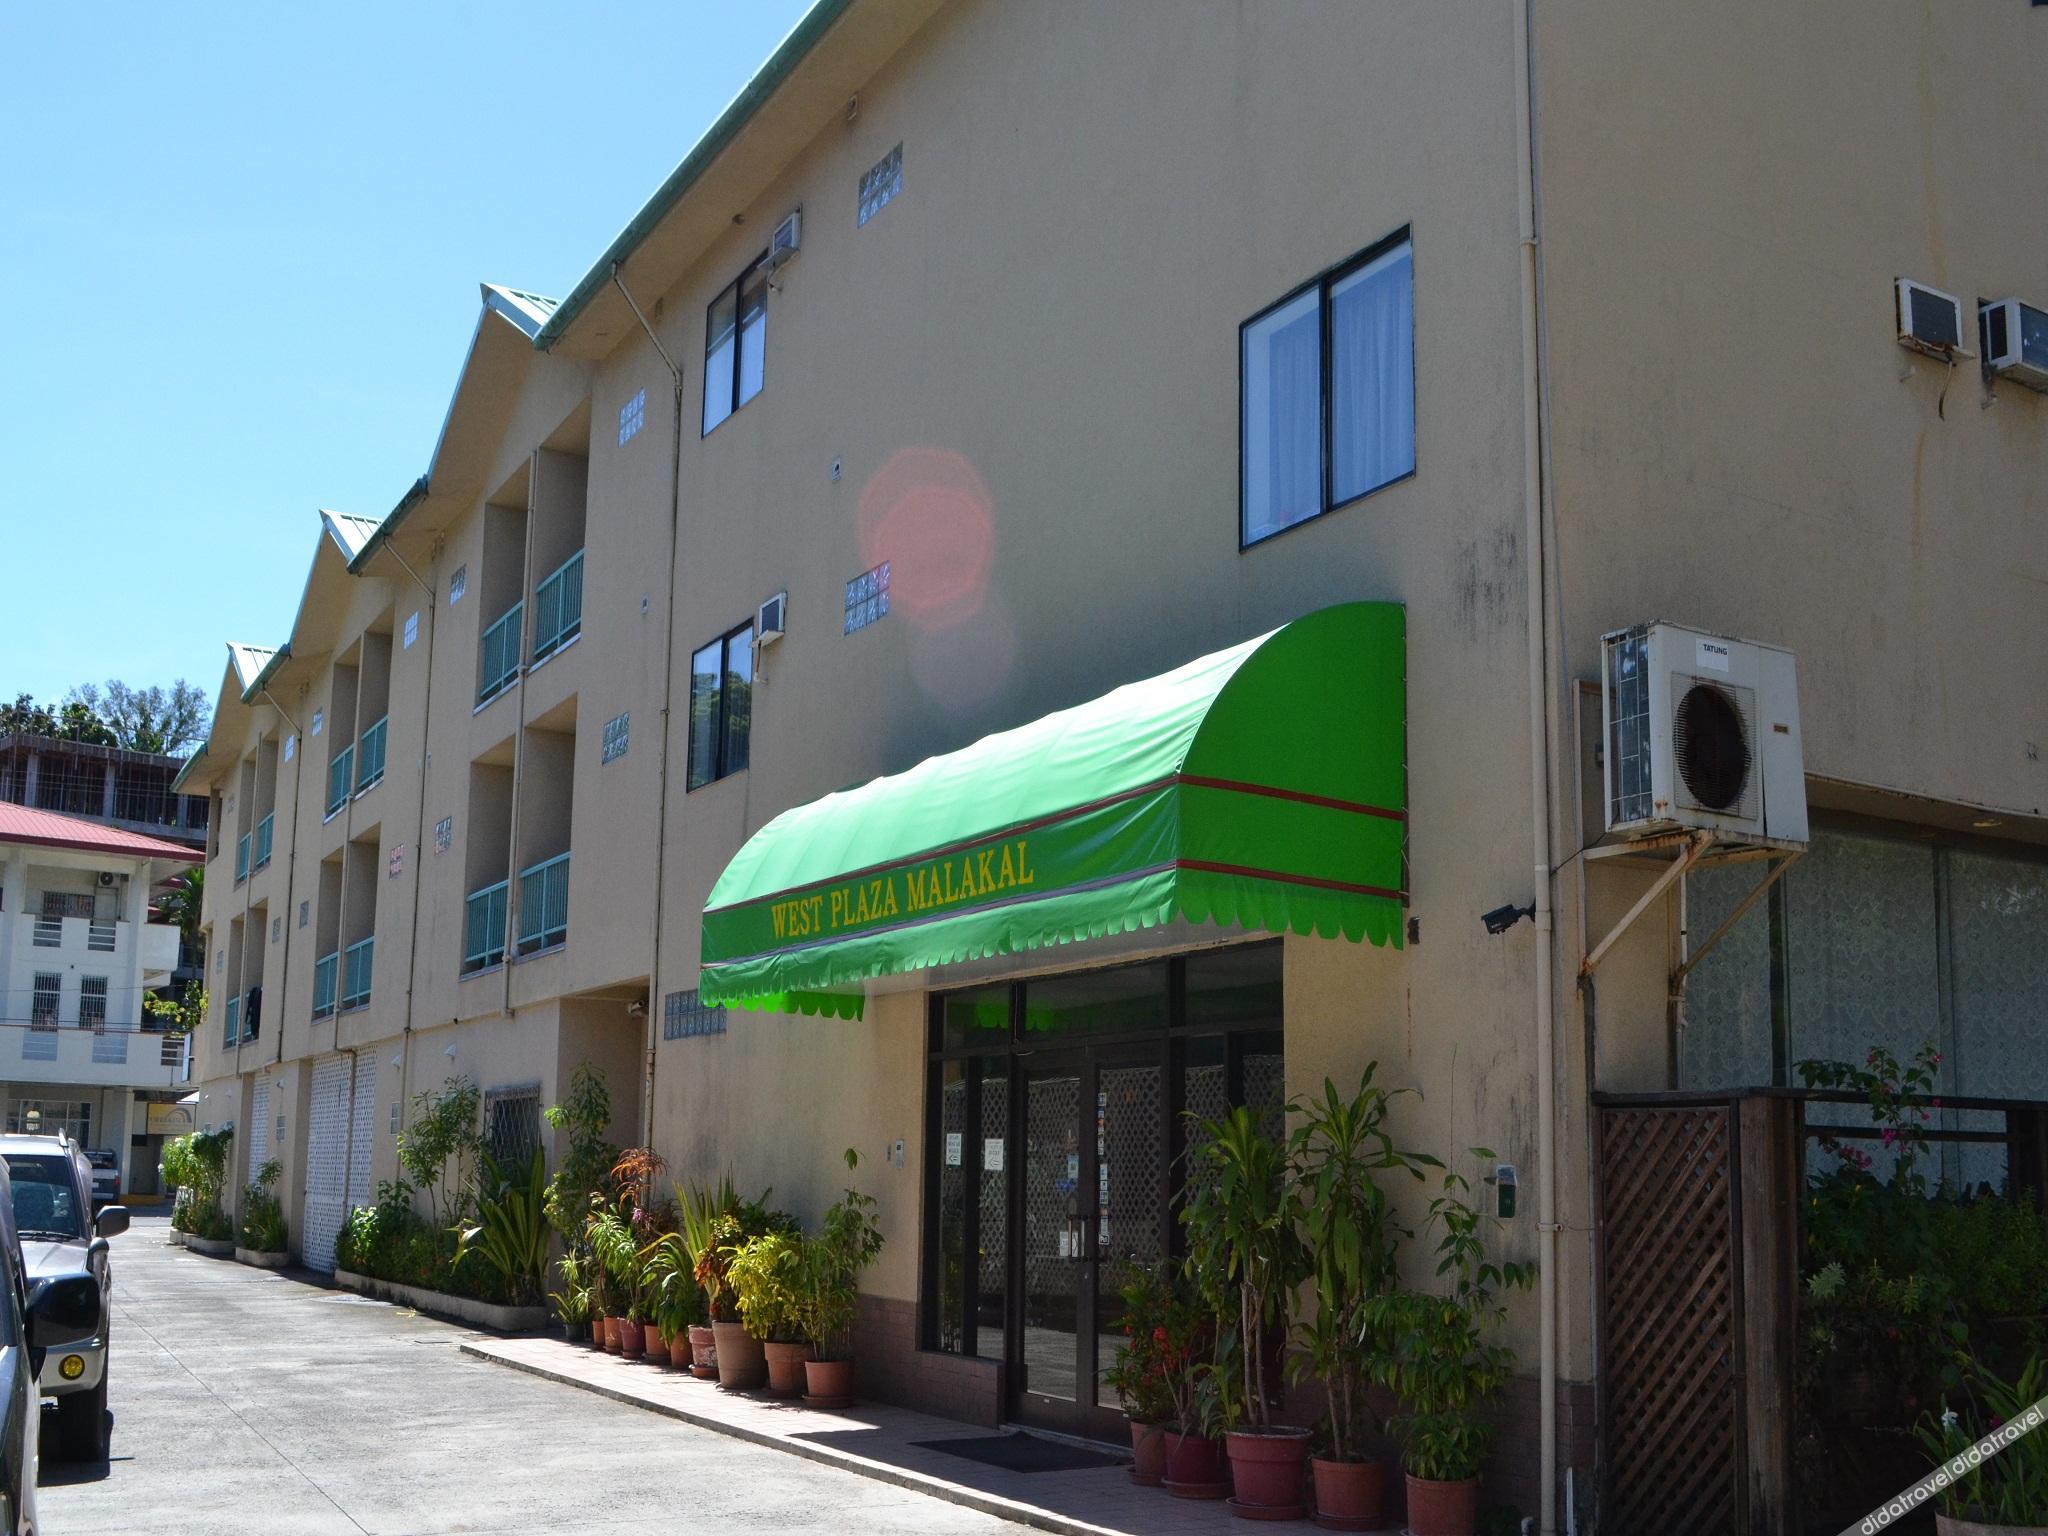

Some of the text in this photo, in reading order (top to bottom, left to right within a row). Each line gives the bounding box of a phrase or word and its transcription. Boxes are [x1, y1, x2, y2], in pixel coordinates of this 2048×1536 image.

[1703, 643, 1727, 655] TATUNG
[771, 841, 1034, 939] WEST PLAZA MALAKAL
